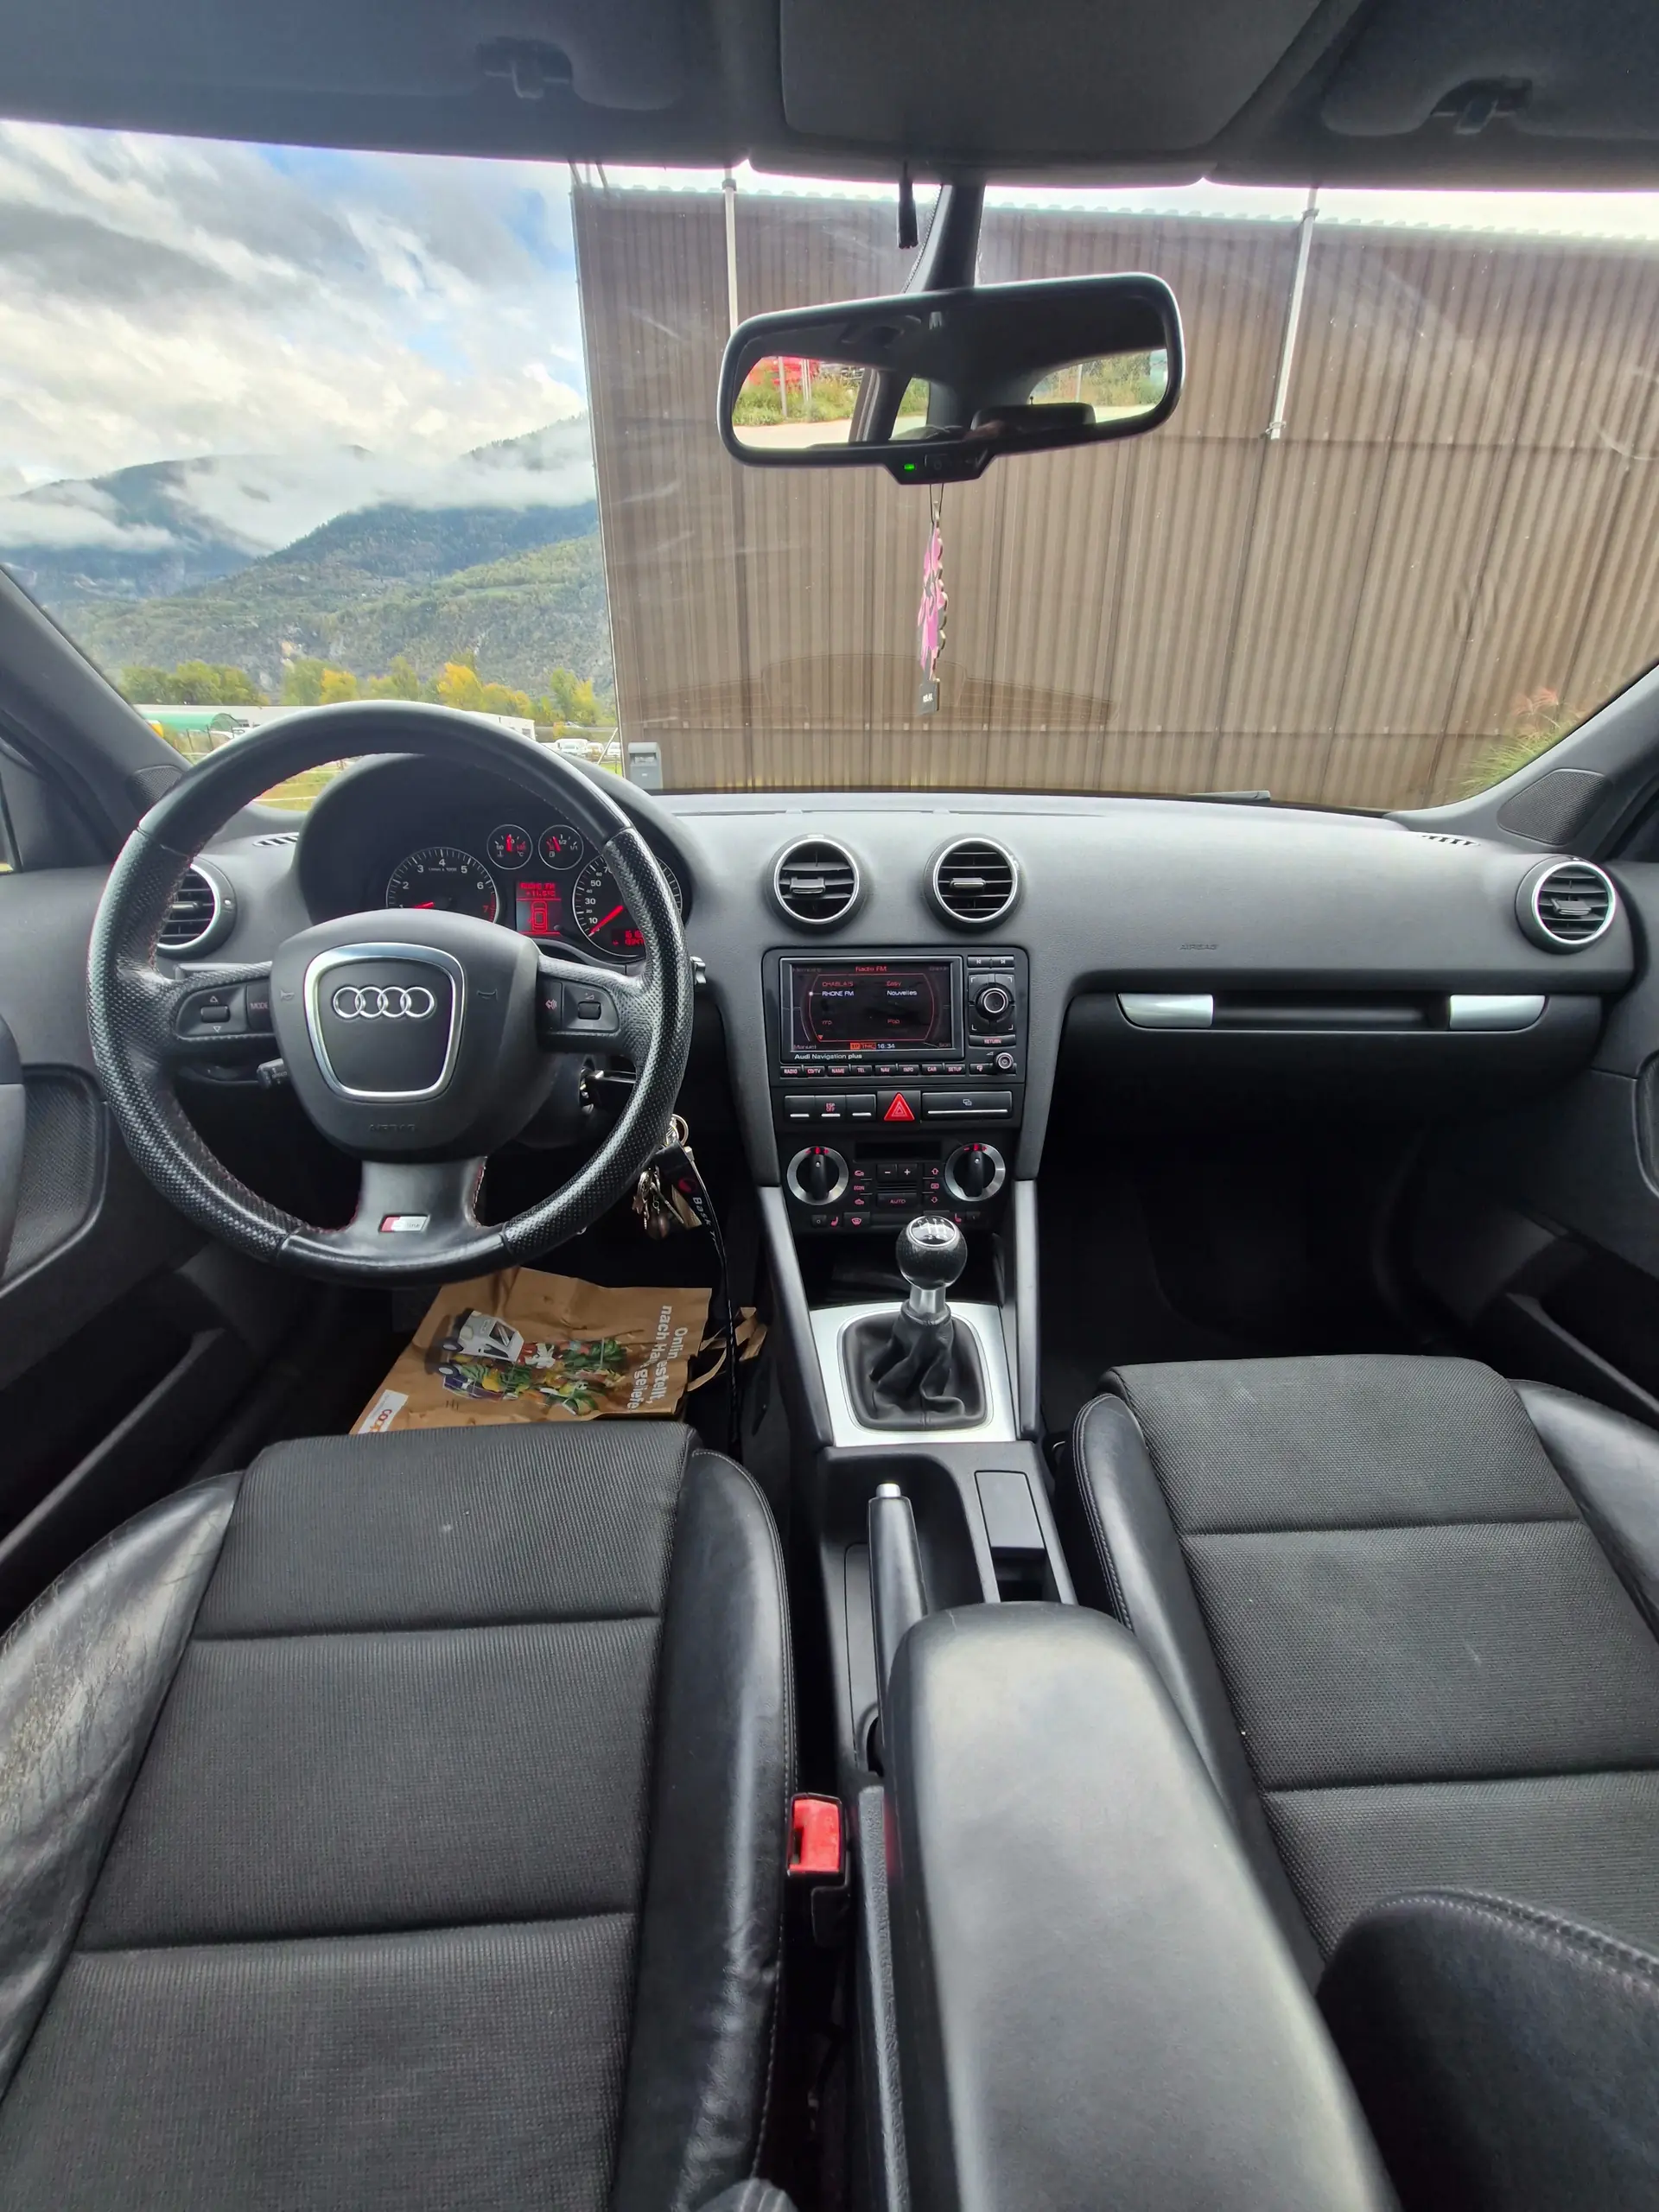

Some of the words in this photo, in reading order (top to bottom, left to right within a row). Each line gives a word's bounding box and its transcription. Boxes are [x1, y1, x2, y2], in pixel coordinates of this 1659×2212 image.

[655, 1305, 672, 1340] nach
[667, 1327, 688, 1359] Onlin
[645, 1359, 670, 1404] estellt,
